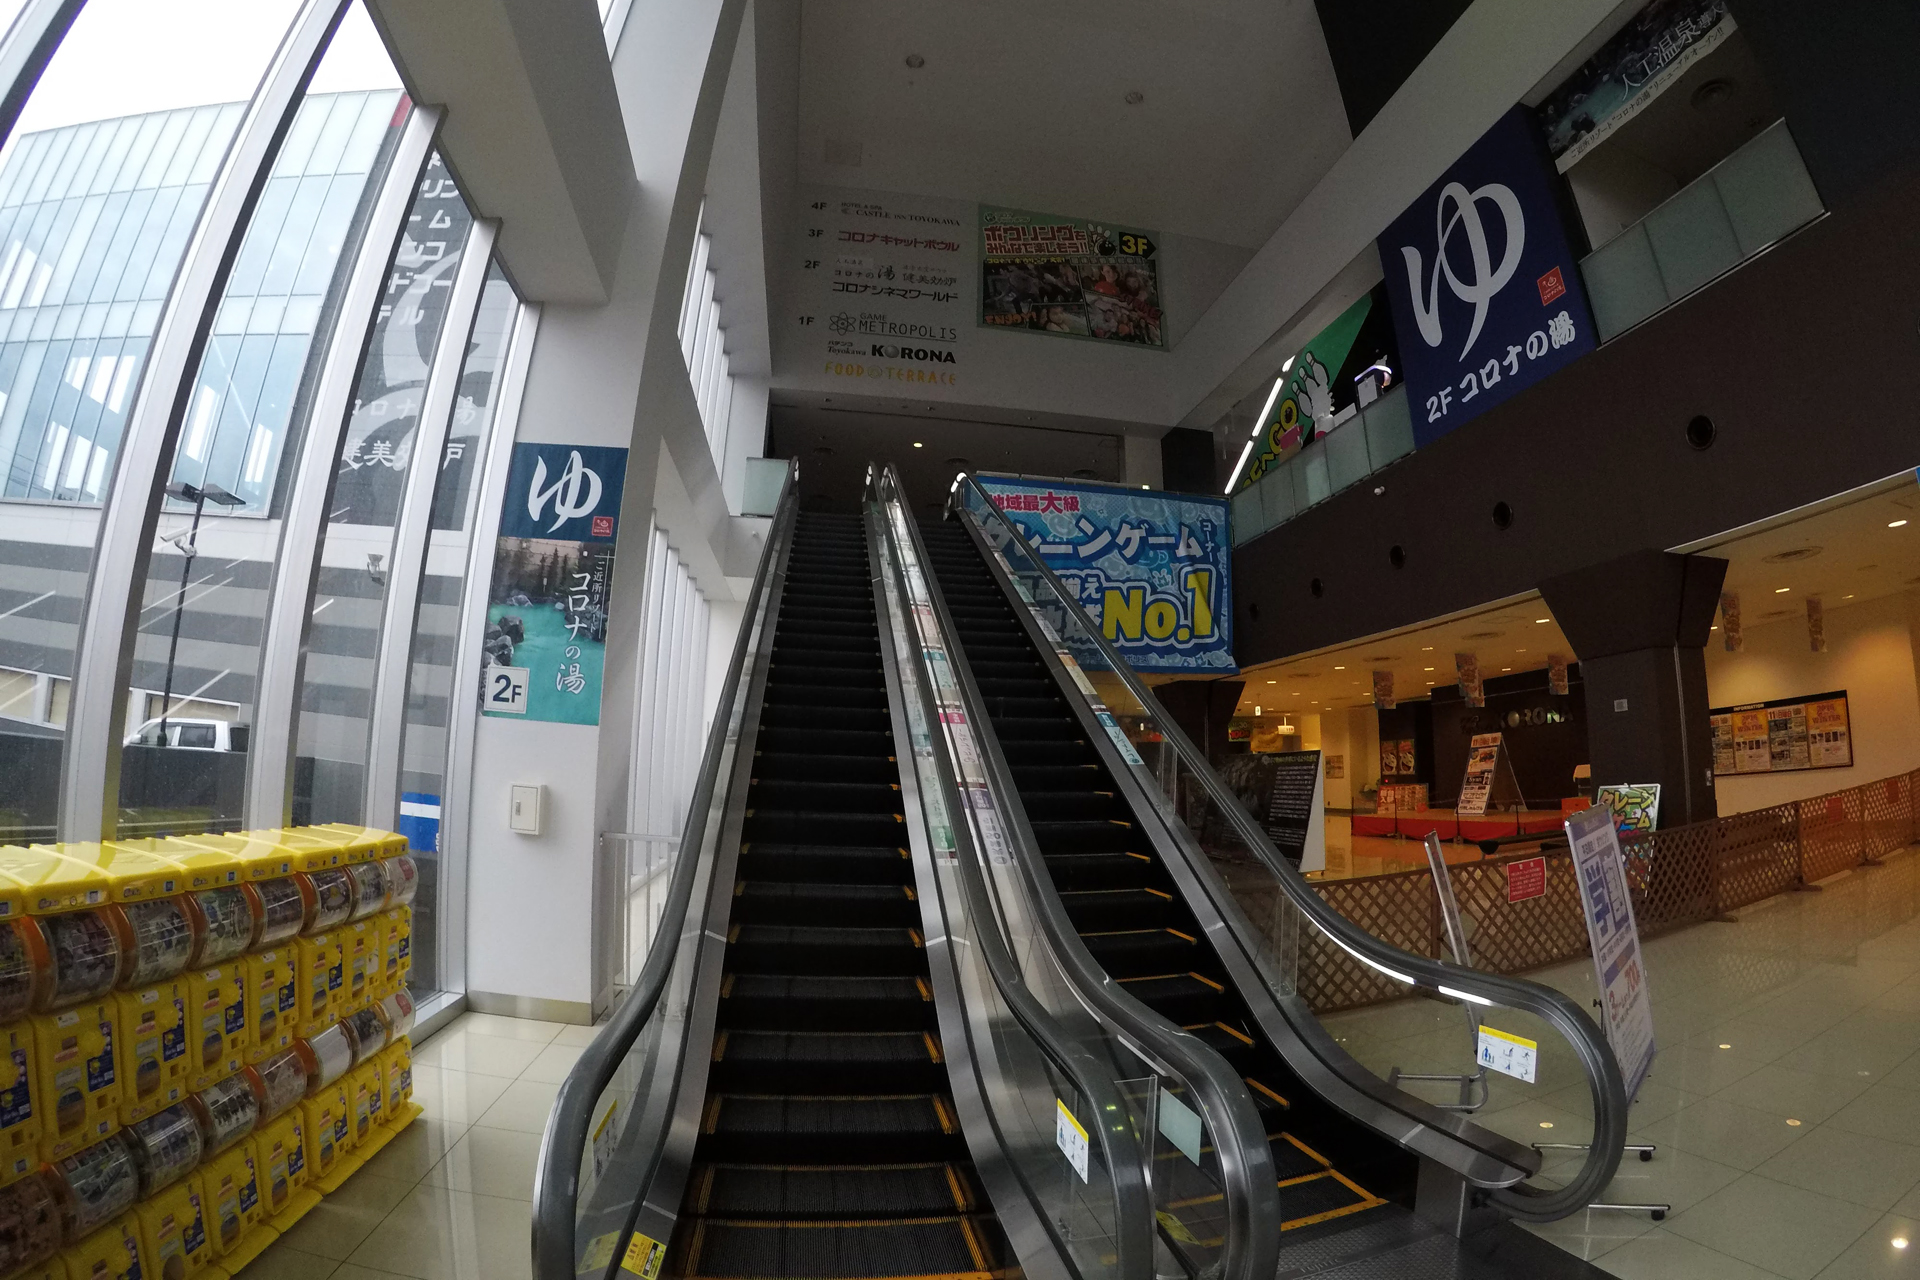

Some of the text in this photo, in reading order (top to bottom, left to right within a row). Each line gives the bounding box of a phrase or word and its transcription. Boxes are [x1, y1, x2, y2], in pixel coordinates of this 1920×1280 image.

[811, 202, 827, 210] 4F
[856, 209, 890, 219] CASTLE
[909, 214, 960, 227] TOYOKAWA
[808, 229, 824, 238] 3F
[838, 230, 960, 252] コロナキャットボウル
[983, 225, 1087, 242] ボウリングを
[1120, 234, 1149, 255] 3F
[804, 260, 820, 269] 2F
[835, 265, 895, 281] コロナの湯
[1400, 181, 1525, 362] ゆ
[832, 281, 959, 303] コロナシネマワールド
[799, 316, 815, 325] 1F
[860, 312, 887, 321] GAME
[859, 320, 957, 340] METROPOLIS
[824, 361, 957, 386] FOOD TERRACE
[1426, 310, 1576, 424] 2F コロナの湯
[527, 449, 603, 534] ゆ
[991, 492, 1080, 514] 地域最大級
[1201, 522, 1214, 563] コーナー
[1102, 571, 1214, 641] No.1
[556, 572, 591, 695] コロナの湯
[492, 674, 523, 704] 2F
[1733, 703, 1764, 712] INFORMATION
[1600, 790, 1655, 811] クレーン
